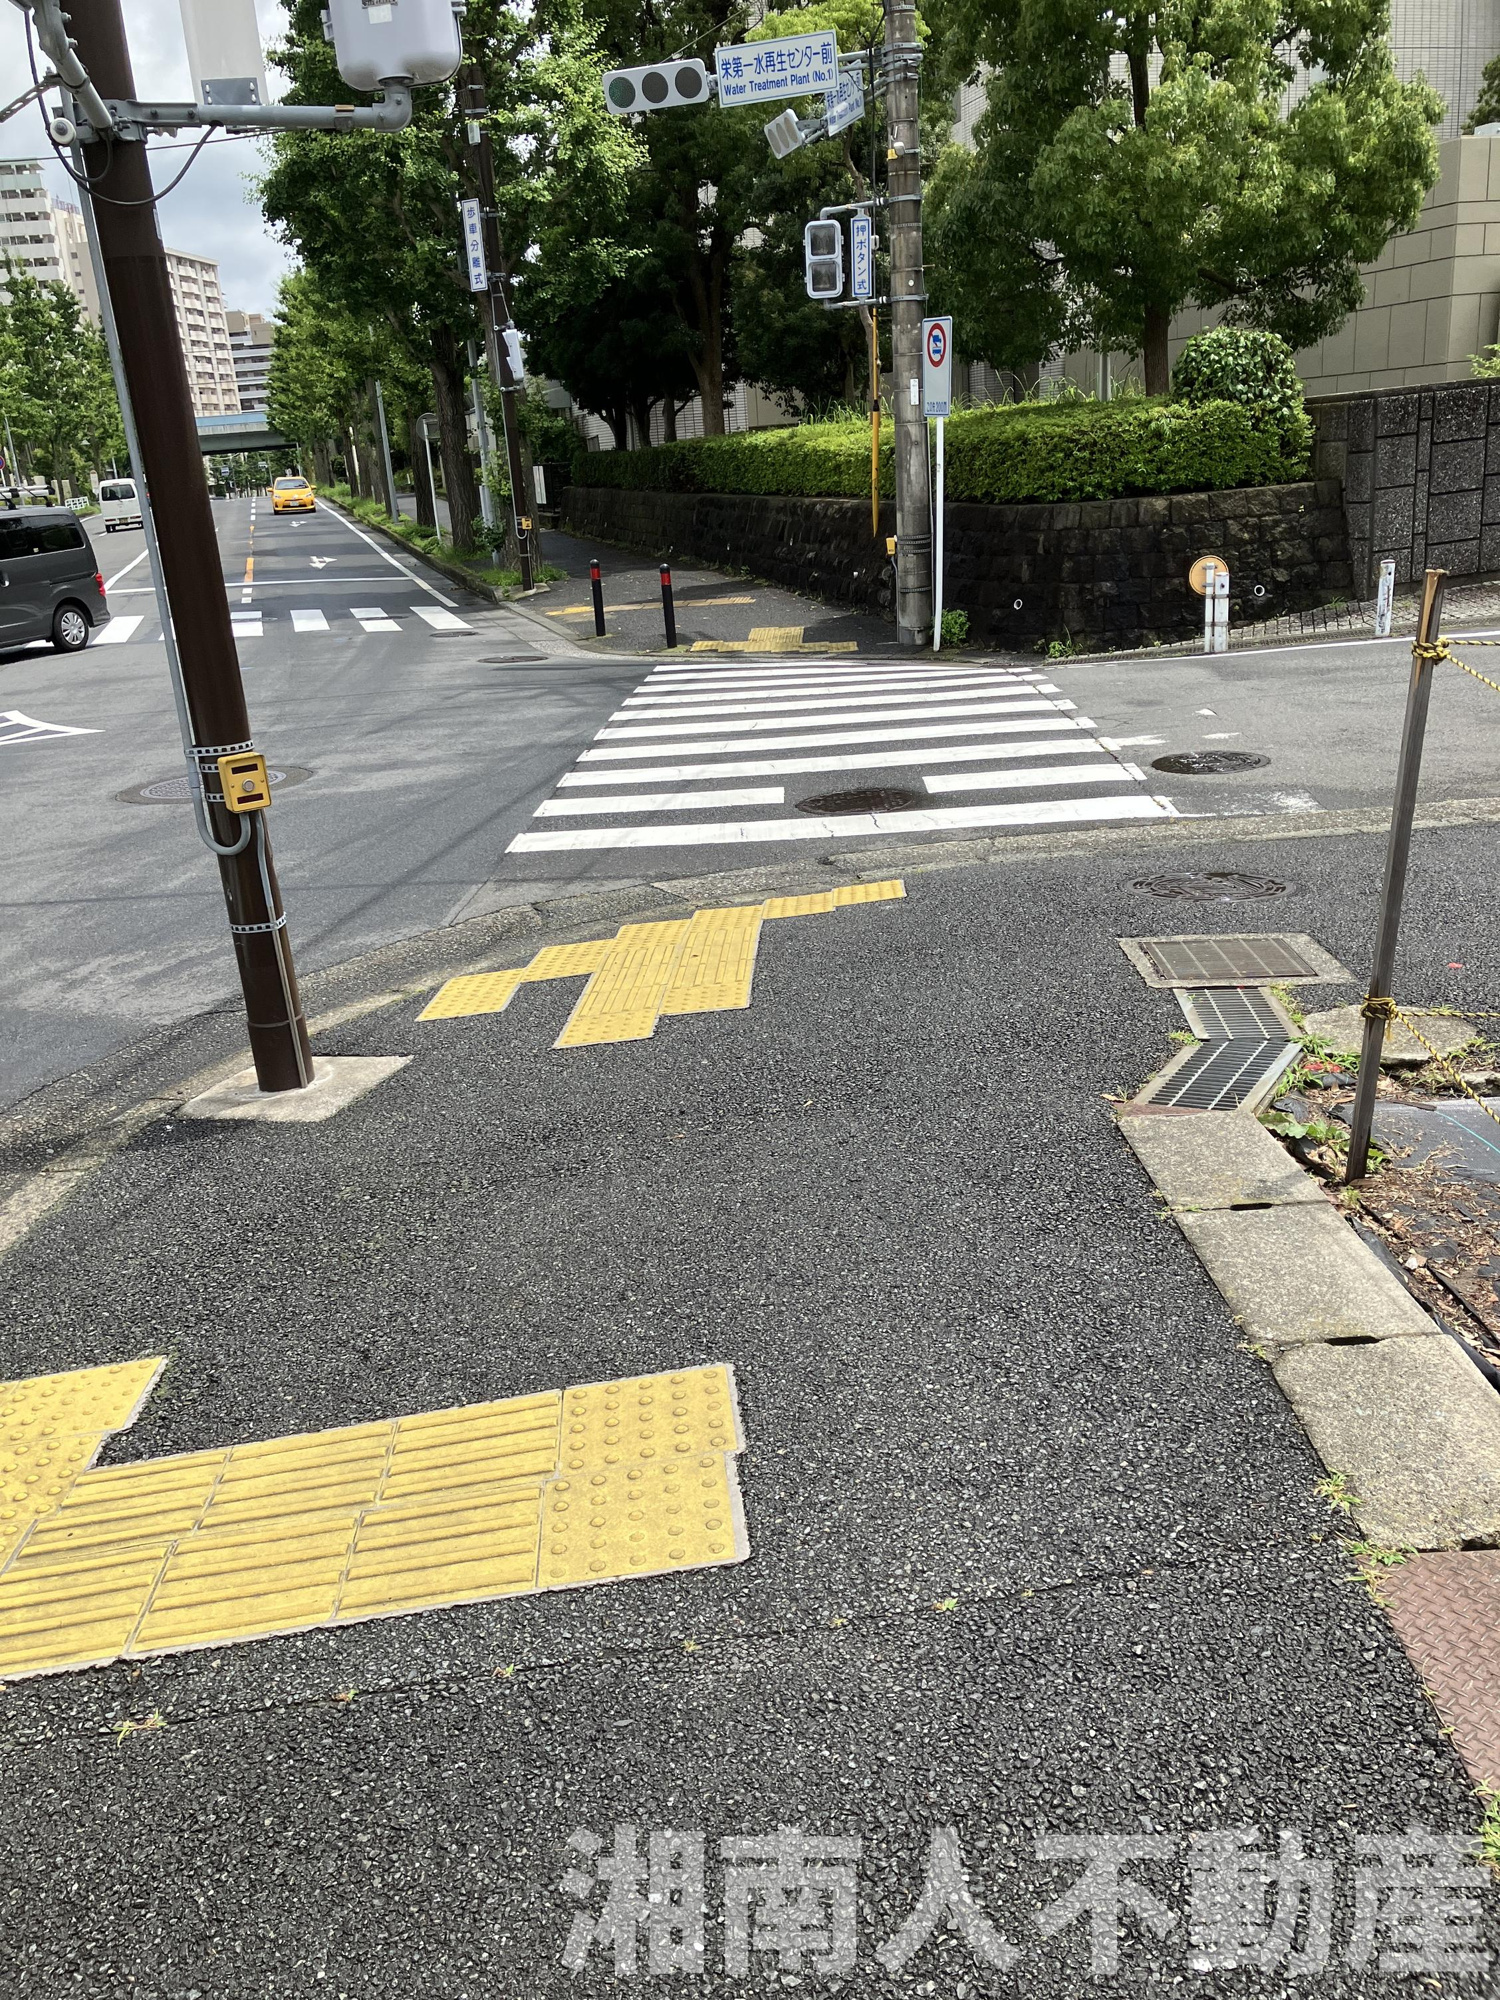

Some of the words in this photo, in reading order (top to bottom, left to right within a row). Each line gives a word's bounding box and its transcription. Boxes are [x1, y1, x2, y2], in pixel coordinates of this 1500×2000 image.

[721, 41, 833, 81] 栄第一水再生センター前
[724, 83, 746, 96] Water
[750, 77, 788, 93] Treatment
[790, 73, 810, 86] Plant
[812, 68, 834, 83] (No.1)
[466, 206, 483, 285] 歩車分離式
[856, 224, 867, 290] 押ボタン式
